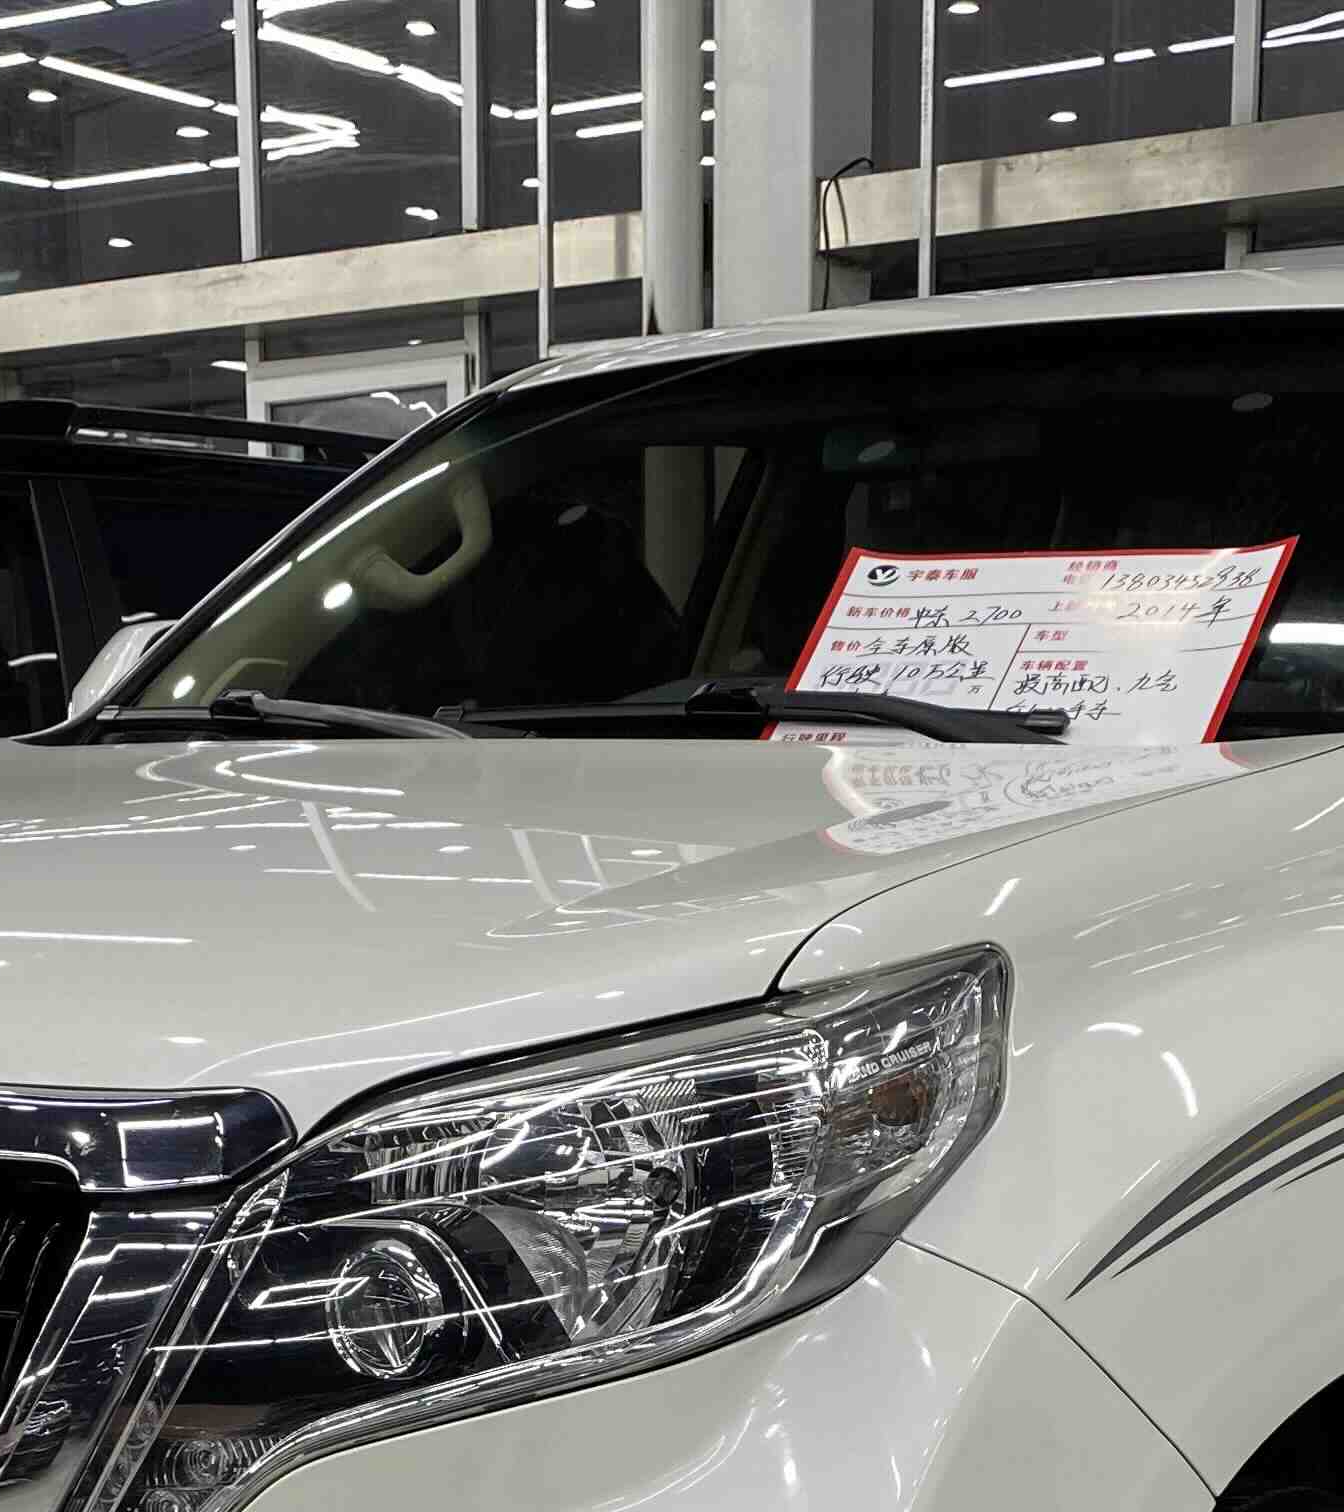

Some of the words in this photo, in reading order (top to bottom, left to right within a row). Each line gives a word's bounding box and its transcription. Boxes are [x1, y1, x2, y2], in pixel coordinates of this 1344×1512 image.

[959, 605, 1023, 626] 2700
[1034, 629, 1070, 641] 车型
[830, 639, 862, 652] 售价
[1020, 660, 1089, 672] 车辆配置
[880, 1041, 932, 1069] CRUISER
